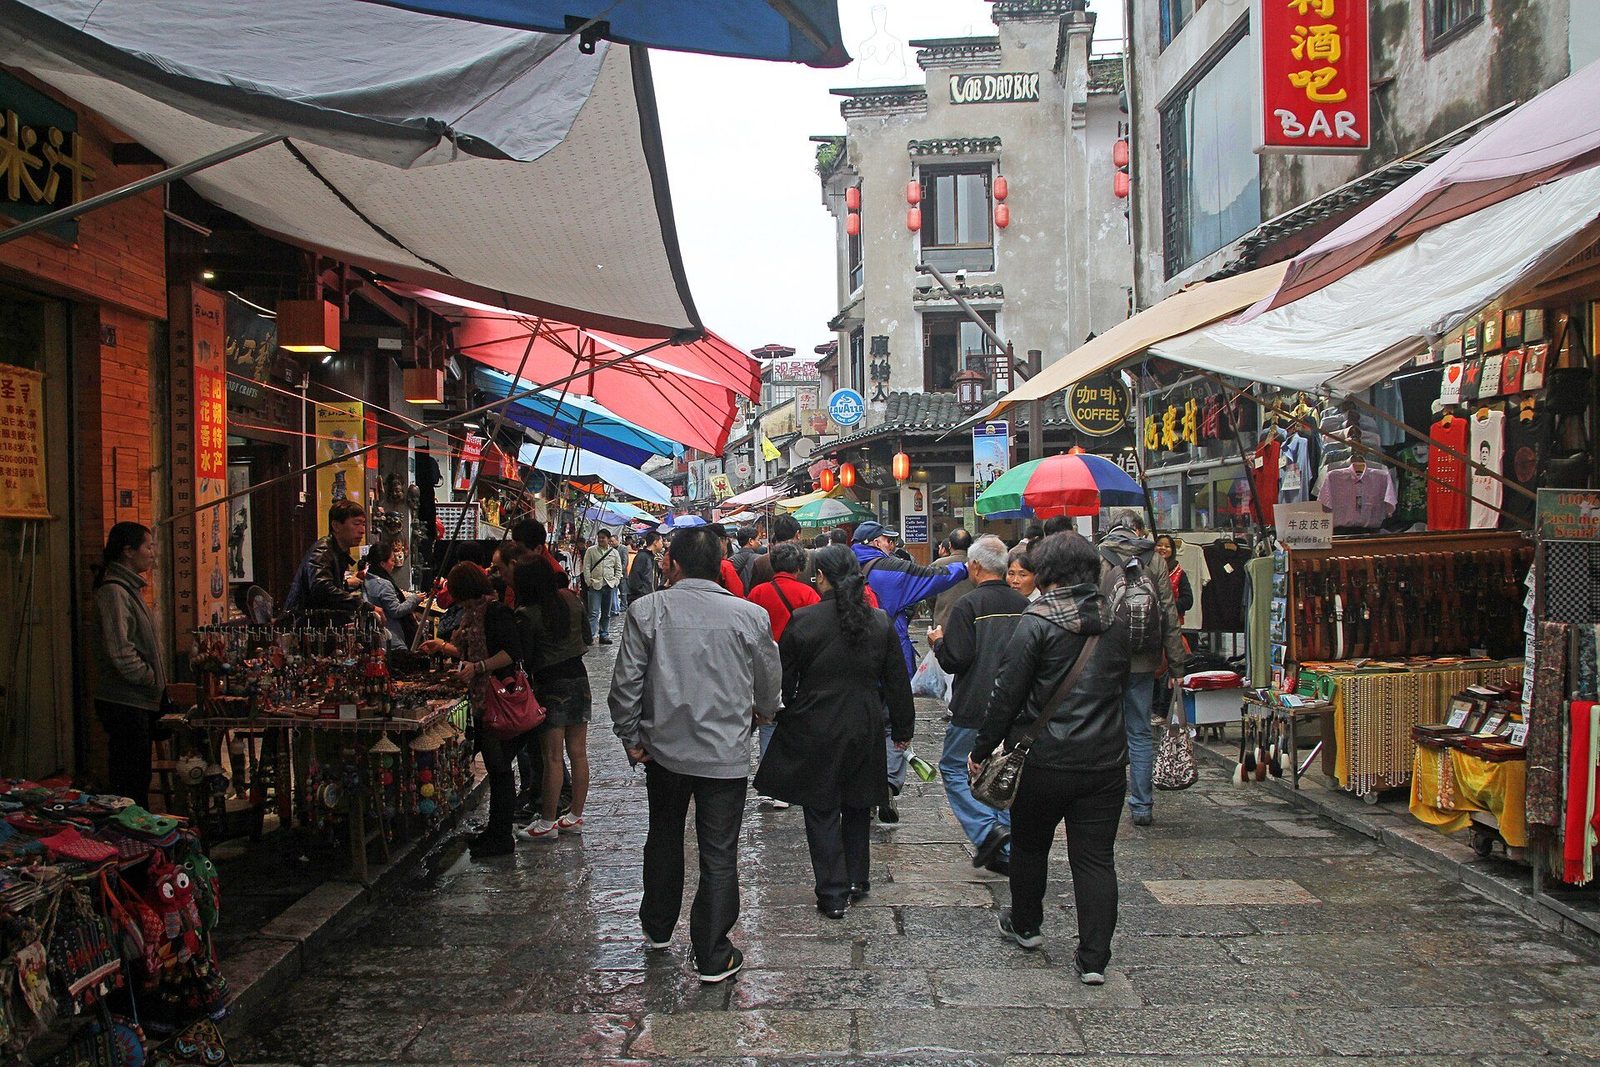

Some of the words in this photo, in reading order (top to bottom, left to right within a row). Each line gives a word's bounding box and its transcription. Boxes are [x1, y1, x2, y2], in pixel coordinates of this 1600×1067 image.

[1274, 108, 1361, 139] BAR
[1076, 385, 1123, 406] 咖啡
[830, 402, 864, 413] LAVAZZA
[1077, 407, 1121, 421] COFFEE
[200, 374, 211, 472] 桂花香水
[213, 377, 223, 473] 阳朔特产
[1288, 519, 1330, 530] 牛皮皮带
